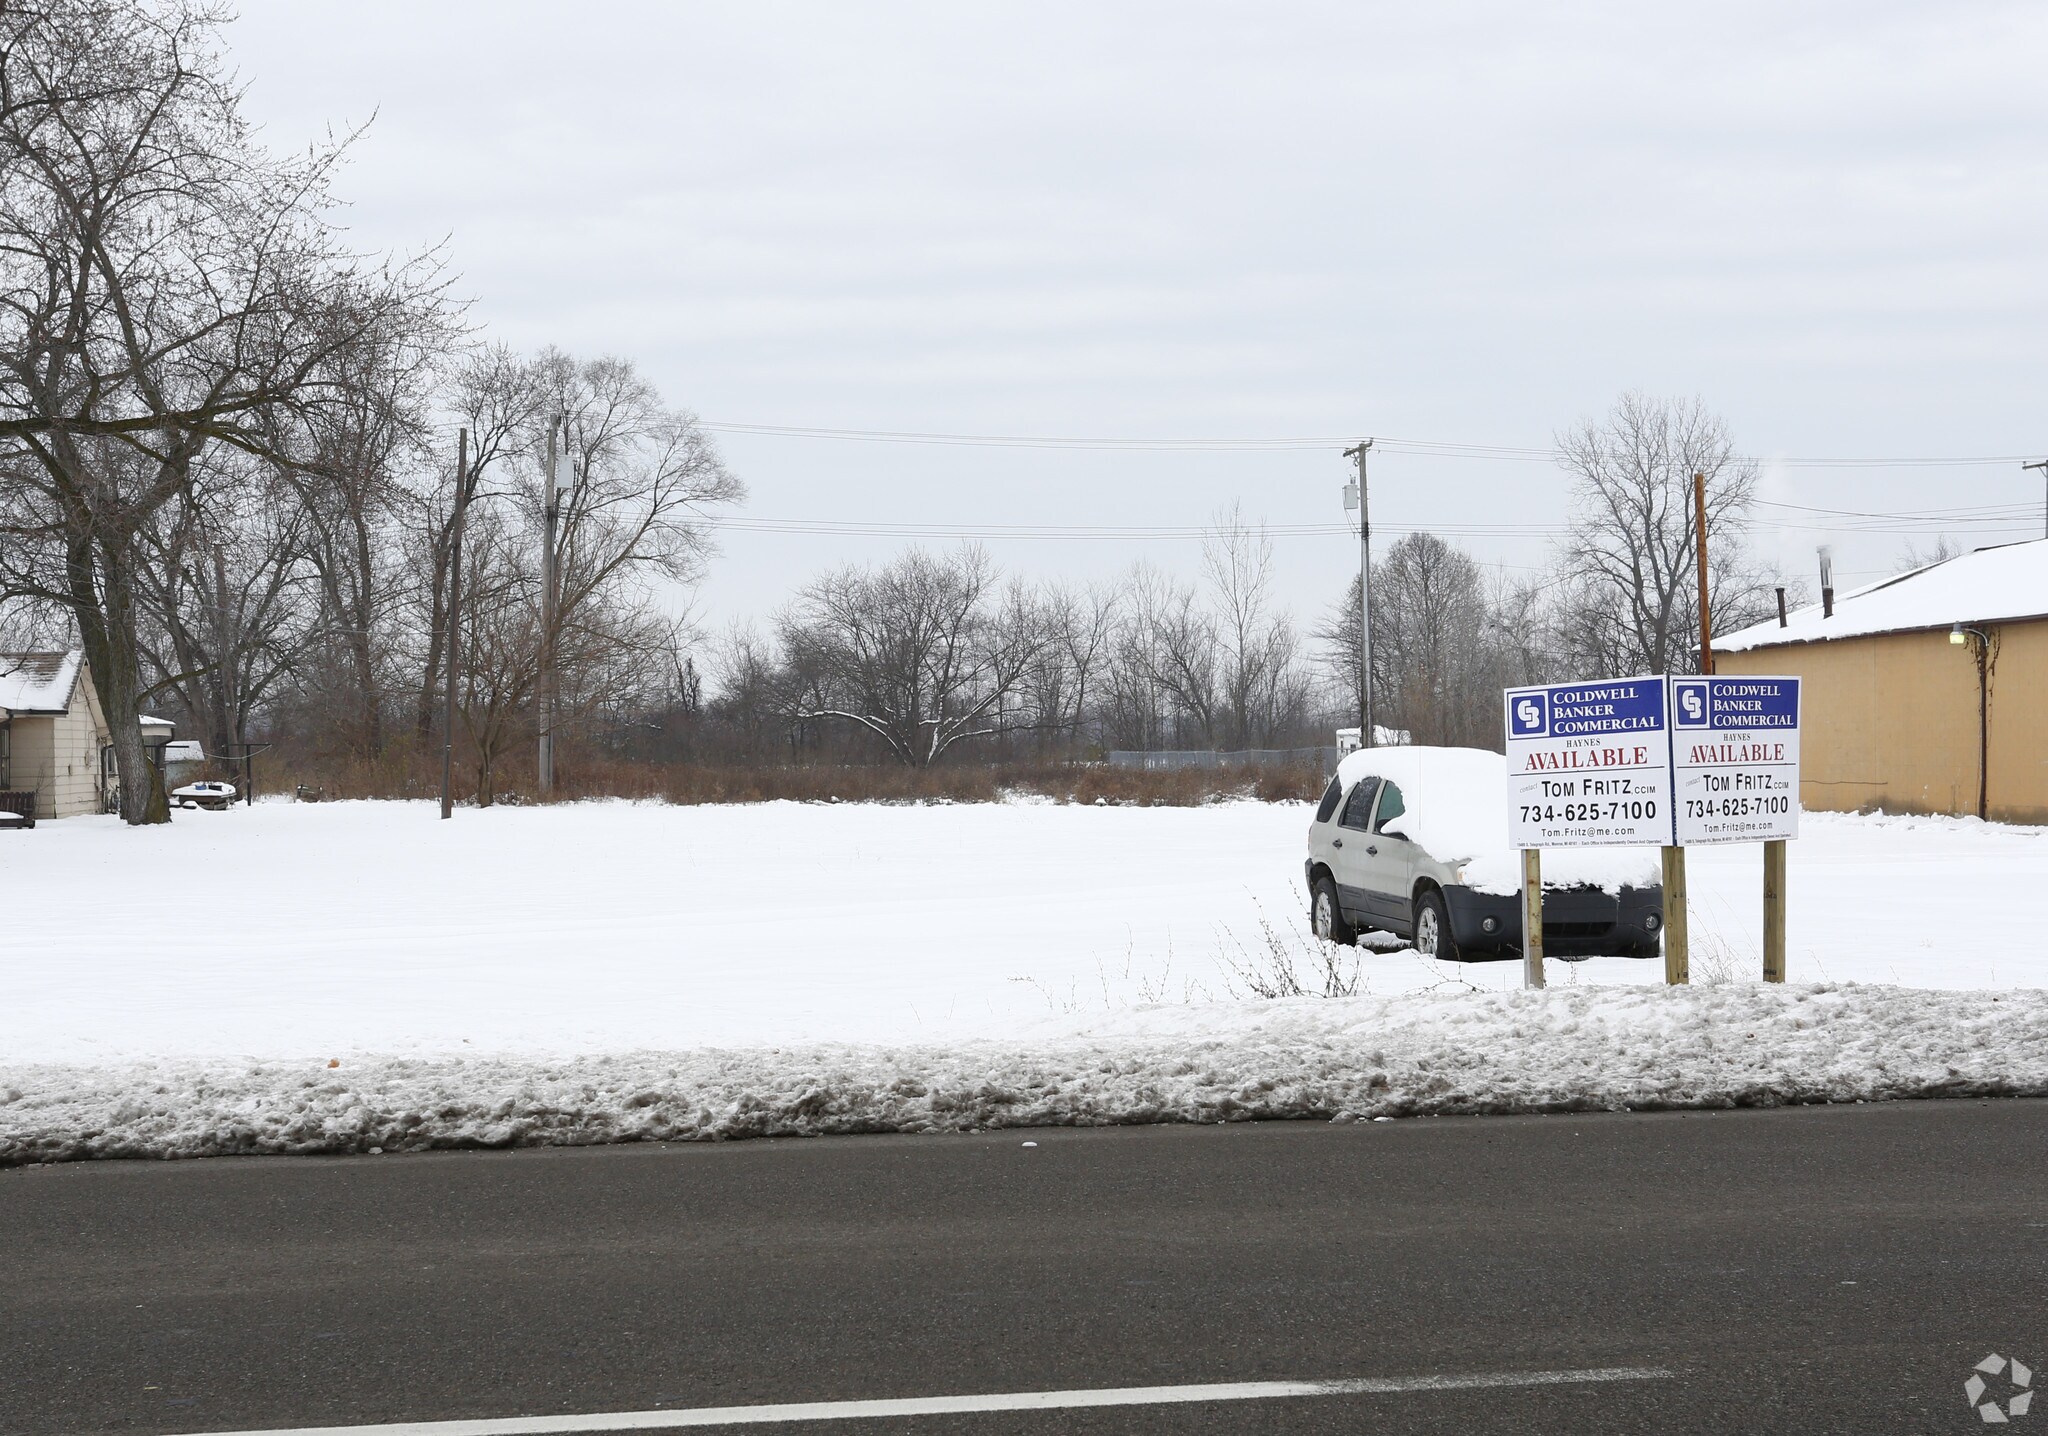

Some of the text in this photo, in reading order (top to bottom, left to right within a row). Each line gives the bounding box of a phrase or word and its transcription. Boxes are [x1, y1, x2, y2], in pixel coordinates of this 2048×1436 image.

[1553, 687, 1639, 704] COLDWELL
[1713, 684, 1781, 696] COLDWELL
[1553, 704, 1615, 719] BANKER
[1713, 699, 1763, 711] BANKER
[1554, 716, 1659, 734] COMMERCIAL
[1714, 714, 1794, 726] COMMERCIAL
[1566, 738, 1601, 748] HAYNES
[1723, 733, 1751, 741] HAYNES
[1525, 746, 1648, 771] AVAILABLE
[1690, 743, 1785, 763] AVAILABLE
[1541, 781, 1575, 797] TOM
[1703, 774, 1730, 792] TOM
[1520, 801, 1656, 823] 734-625-7100
[1686, 796, 1789, 818] 734-625-7100
[1541, 827, 1635, 838] Tom.Fritz@me.com
[1704, 822, 1773, 833] Tom.Fritz@me.com
